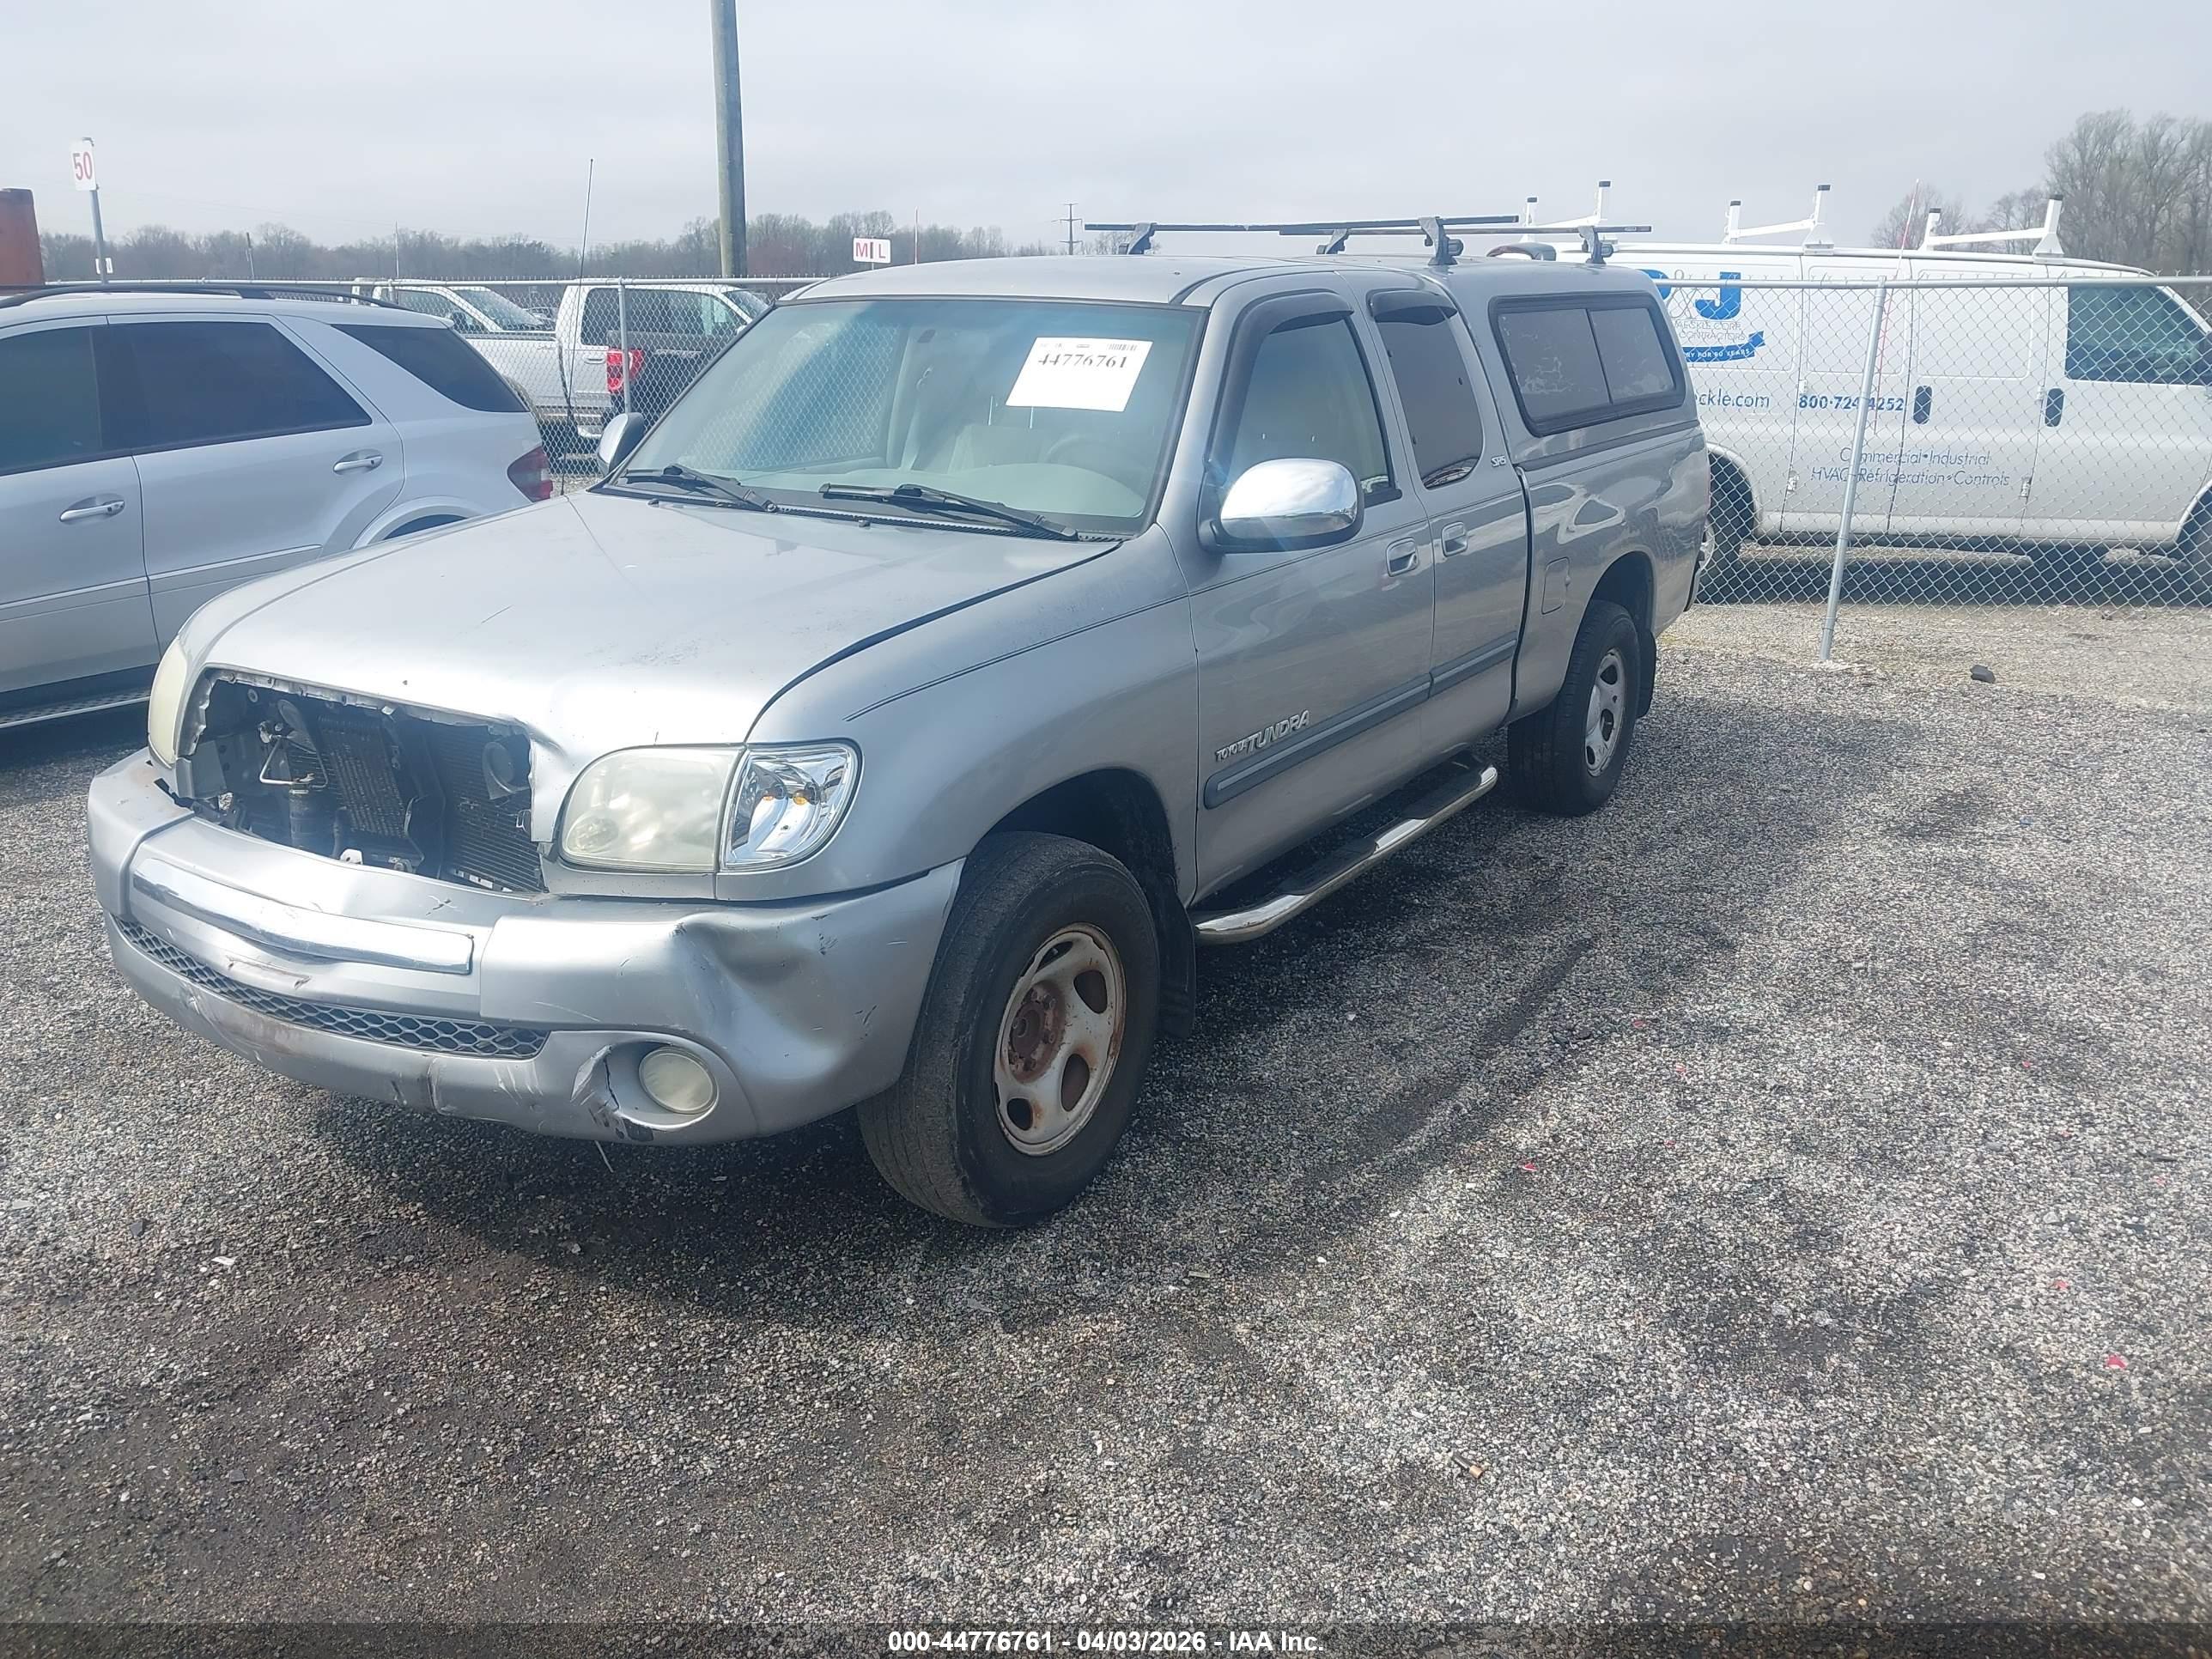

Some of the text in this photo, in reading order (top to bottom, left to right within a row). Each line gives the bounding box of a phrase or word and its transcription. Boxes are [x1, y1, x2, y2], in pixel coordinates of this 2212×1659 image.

[72, 151, 93, 180] 50
[1037, 353, 1127, 368] 44776761
[1727, 347, 1750, 356] YEARS
[1215, 709, 1310, 762] TOYOTA TUNDRA
